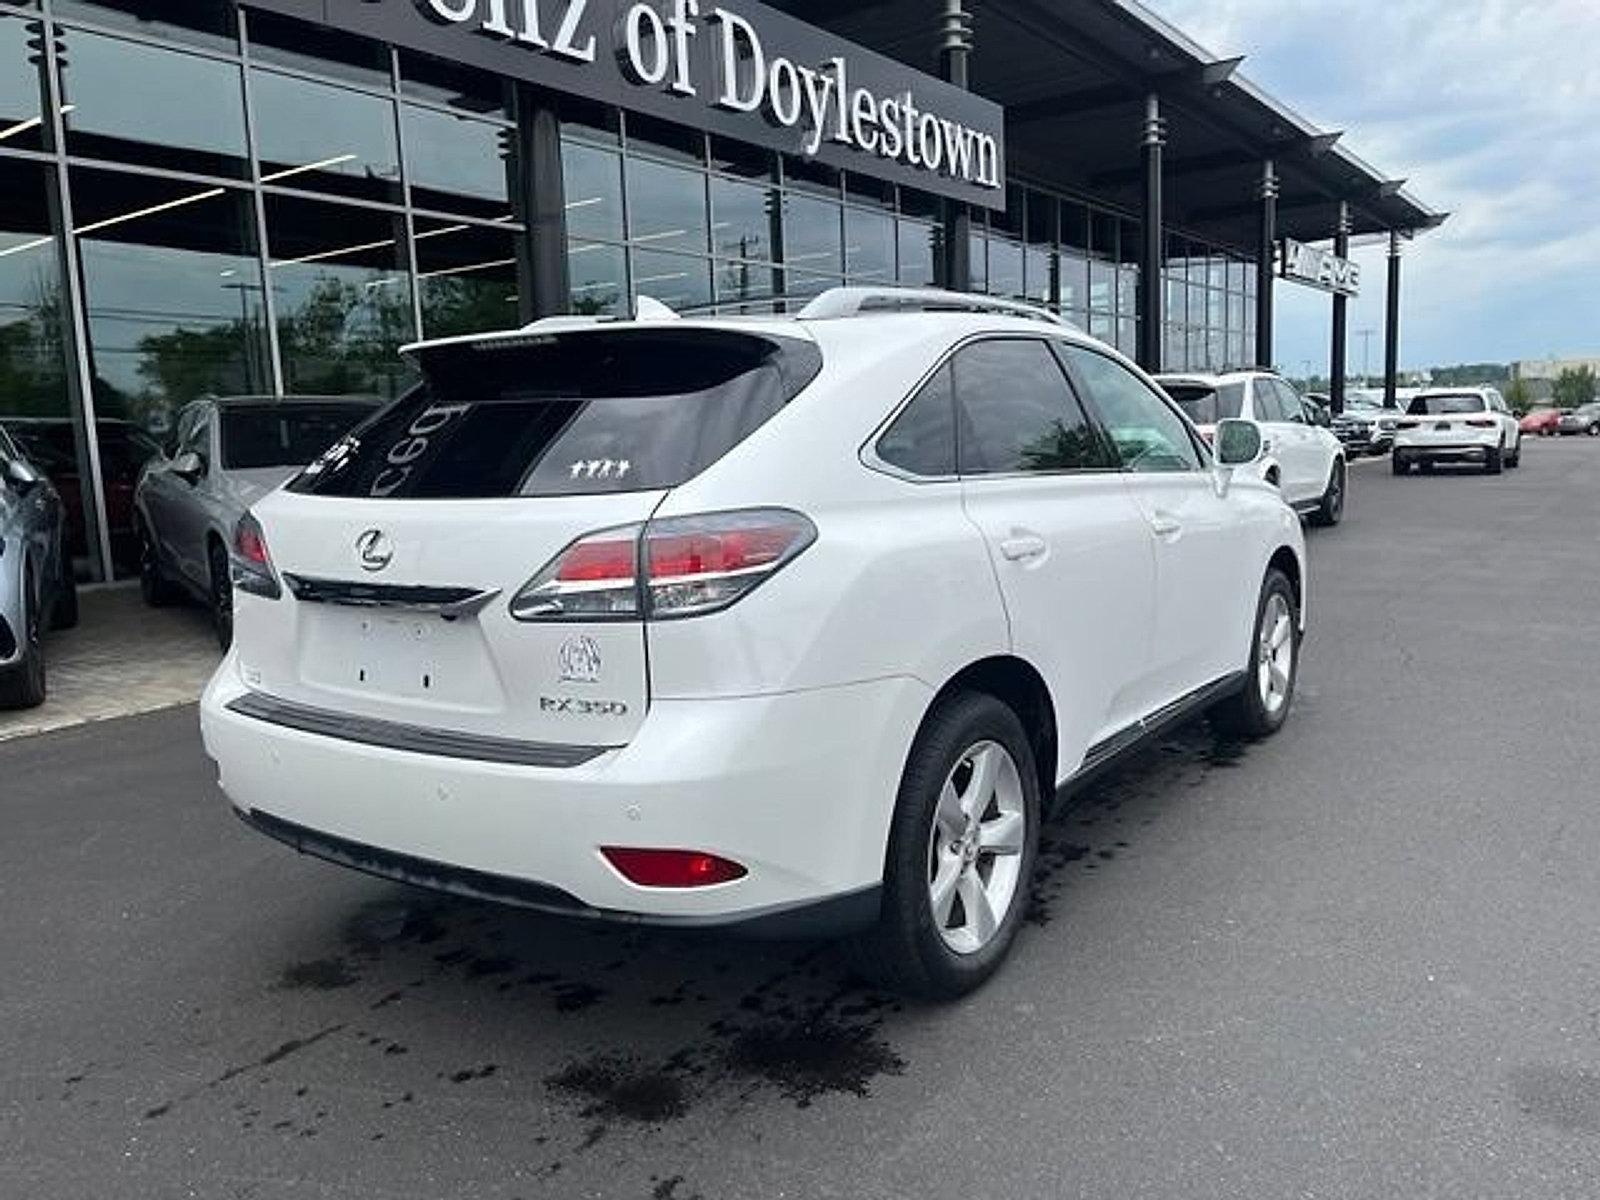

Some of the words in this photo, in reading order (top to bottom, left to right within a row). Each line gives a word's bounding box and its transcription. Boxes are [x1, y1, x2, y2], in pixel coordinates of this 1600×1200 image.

[626, 0, 699, 97] of
[715, 8, 1001, 188] Doylestown
[540, 696, 573, 713] RX
[577, 699, 629, 717] 350
